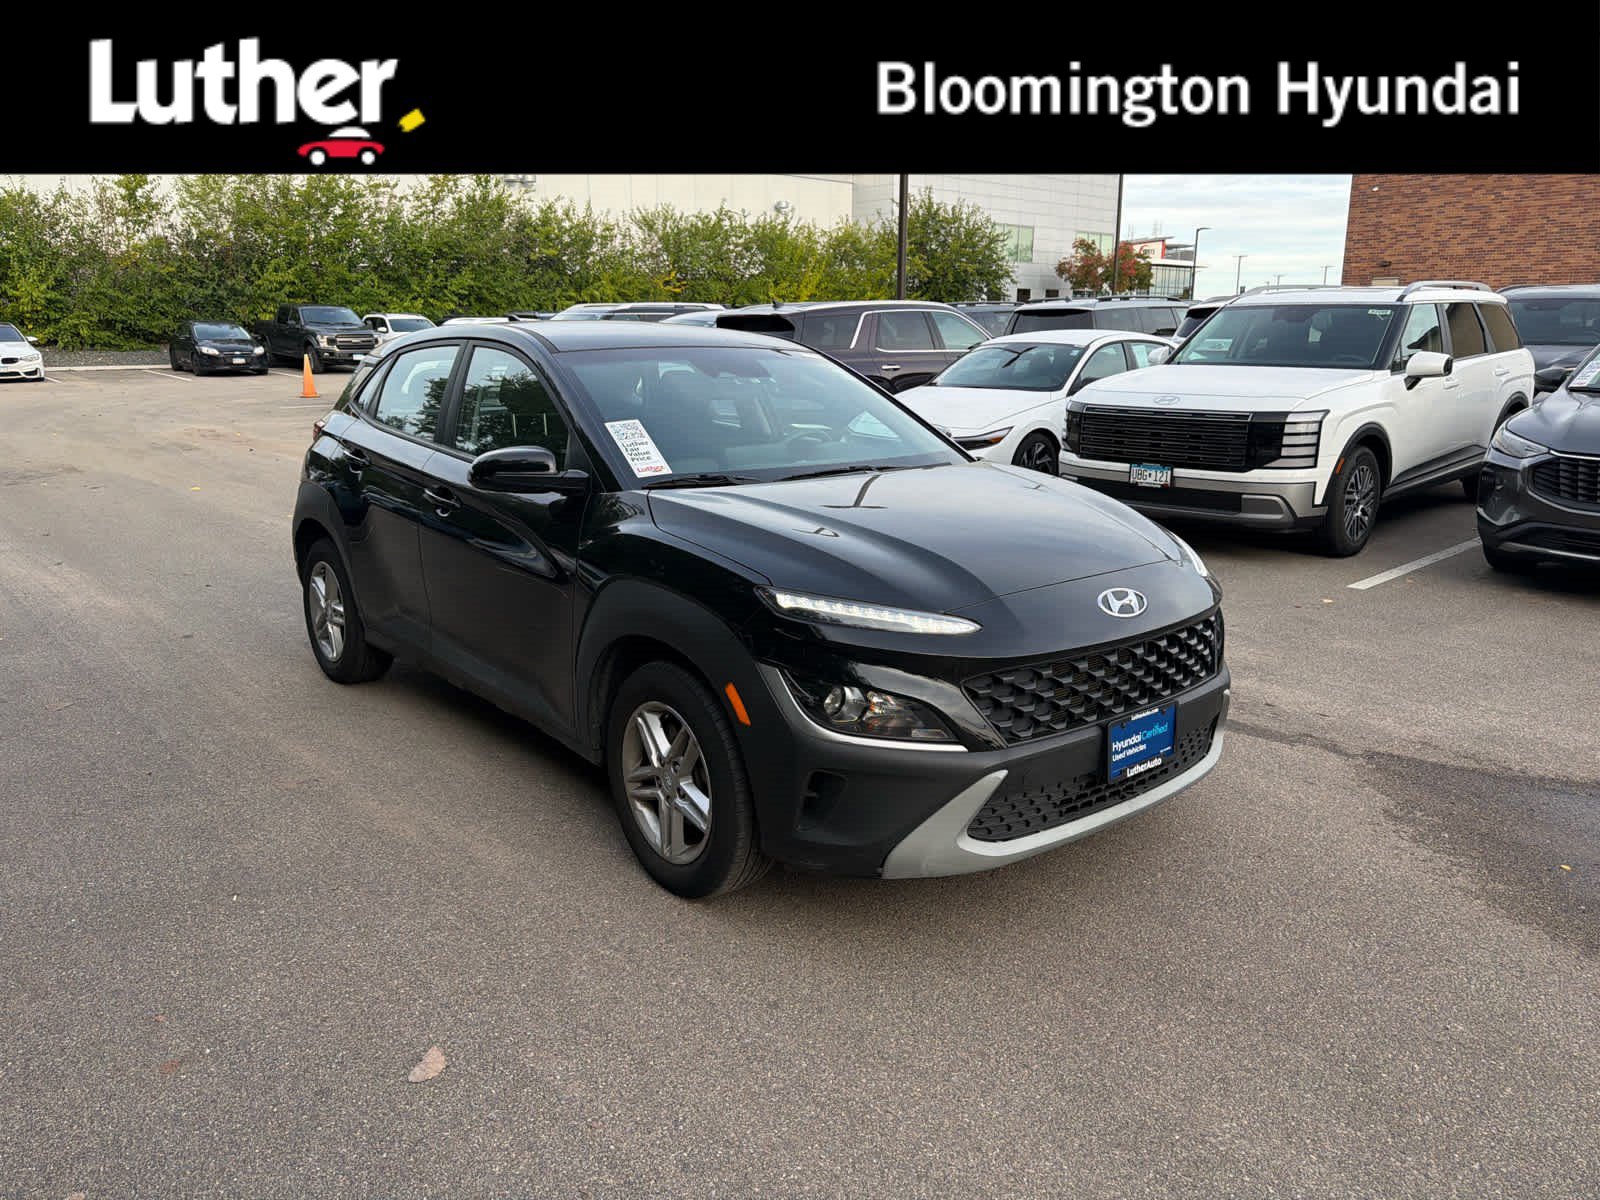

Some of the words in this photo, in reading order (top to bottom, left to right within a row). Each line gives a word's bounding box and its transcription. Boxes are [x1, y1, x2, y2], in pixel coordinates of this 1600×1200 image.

[637, 465, 664, 473] Luther
[1112, 751, 1126, 762] Used
[1126, 743, 1147, 758] Vehicles
[1127, 757, 1162, 778] LutherAuto
